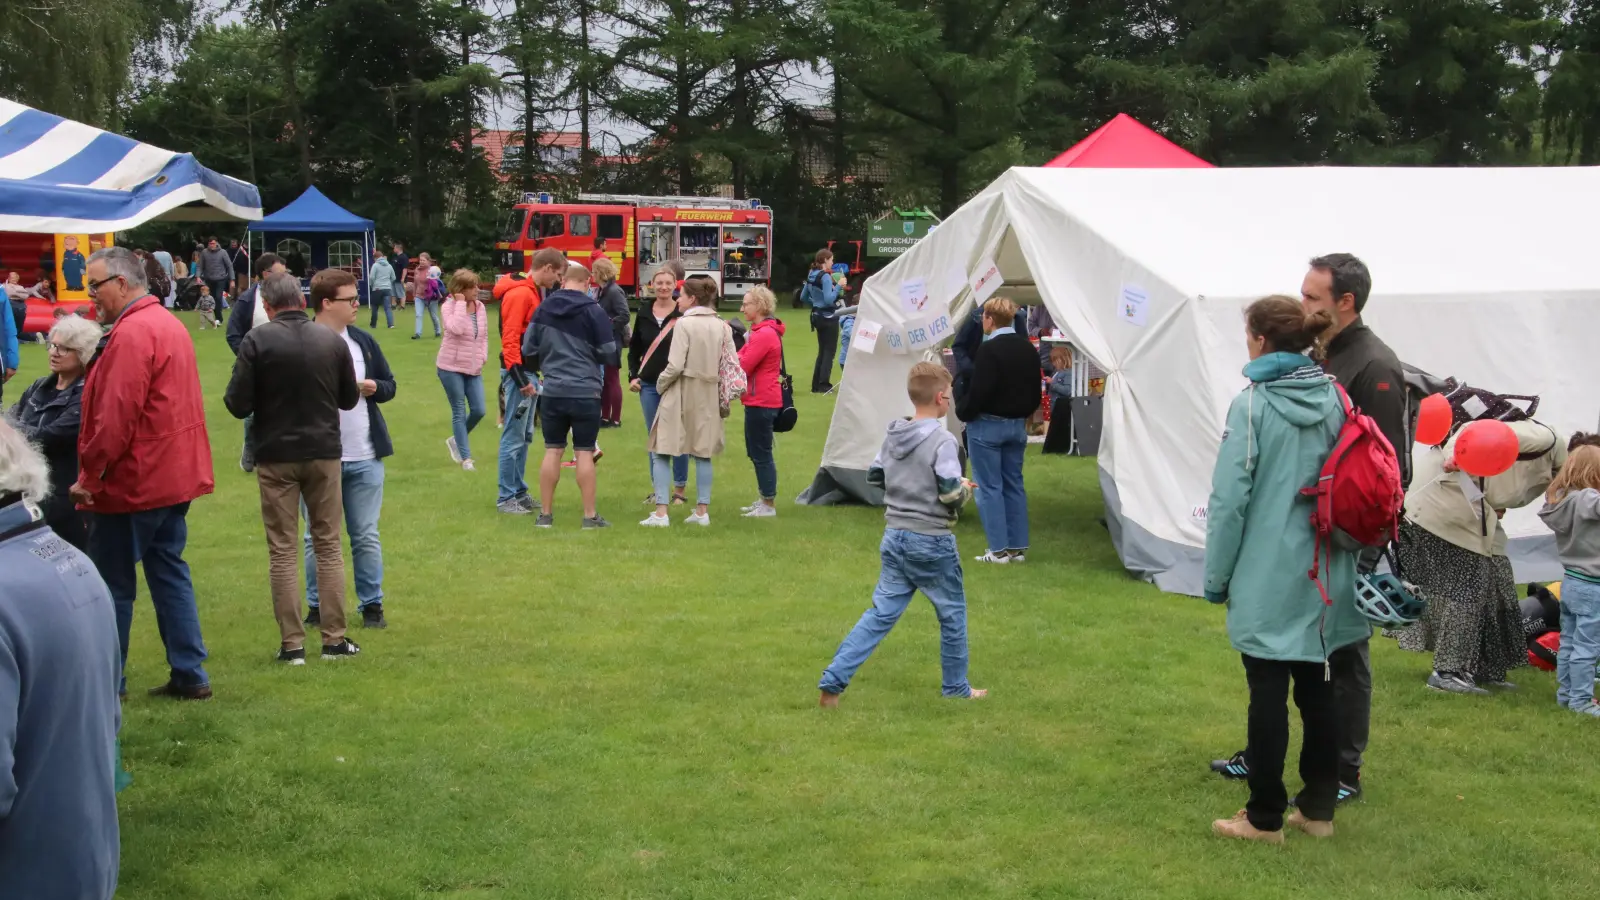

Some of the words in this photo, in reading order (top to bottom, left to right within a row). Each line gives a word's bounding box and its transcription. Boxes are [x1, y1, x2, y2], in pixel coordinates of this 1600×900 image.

[675, 210, 734, 221] FEUERWEHR
[893, 236, 921, 244] SCHÜTZ
[907, 327, 928, 345] DER
[928, 315, 949, 337] VER
